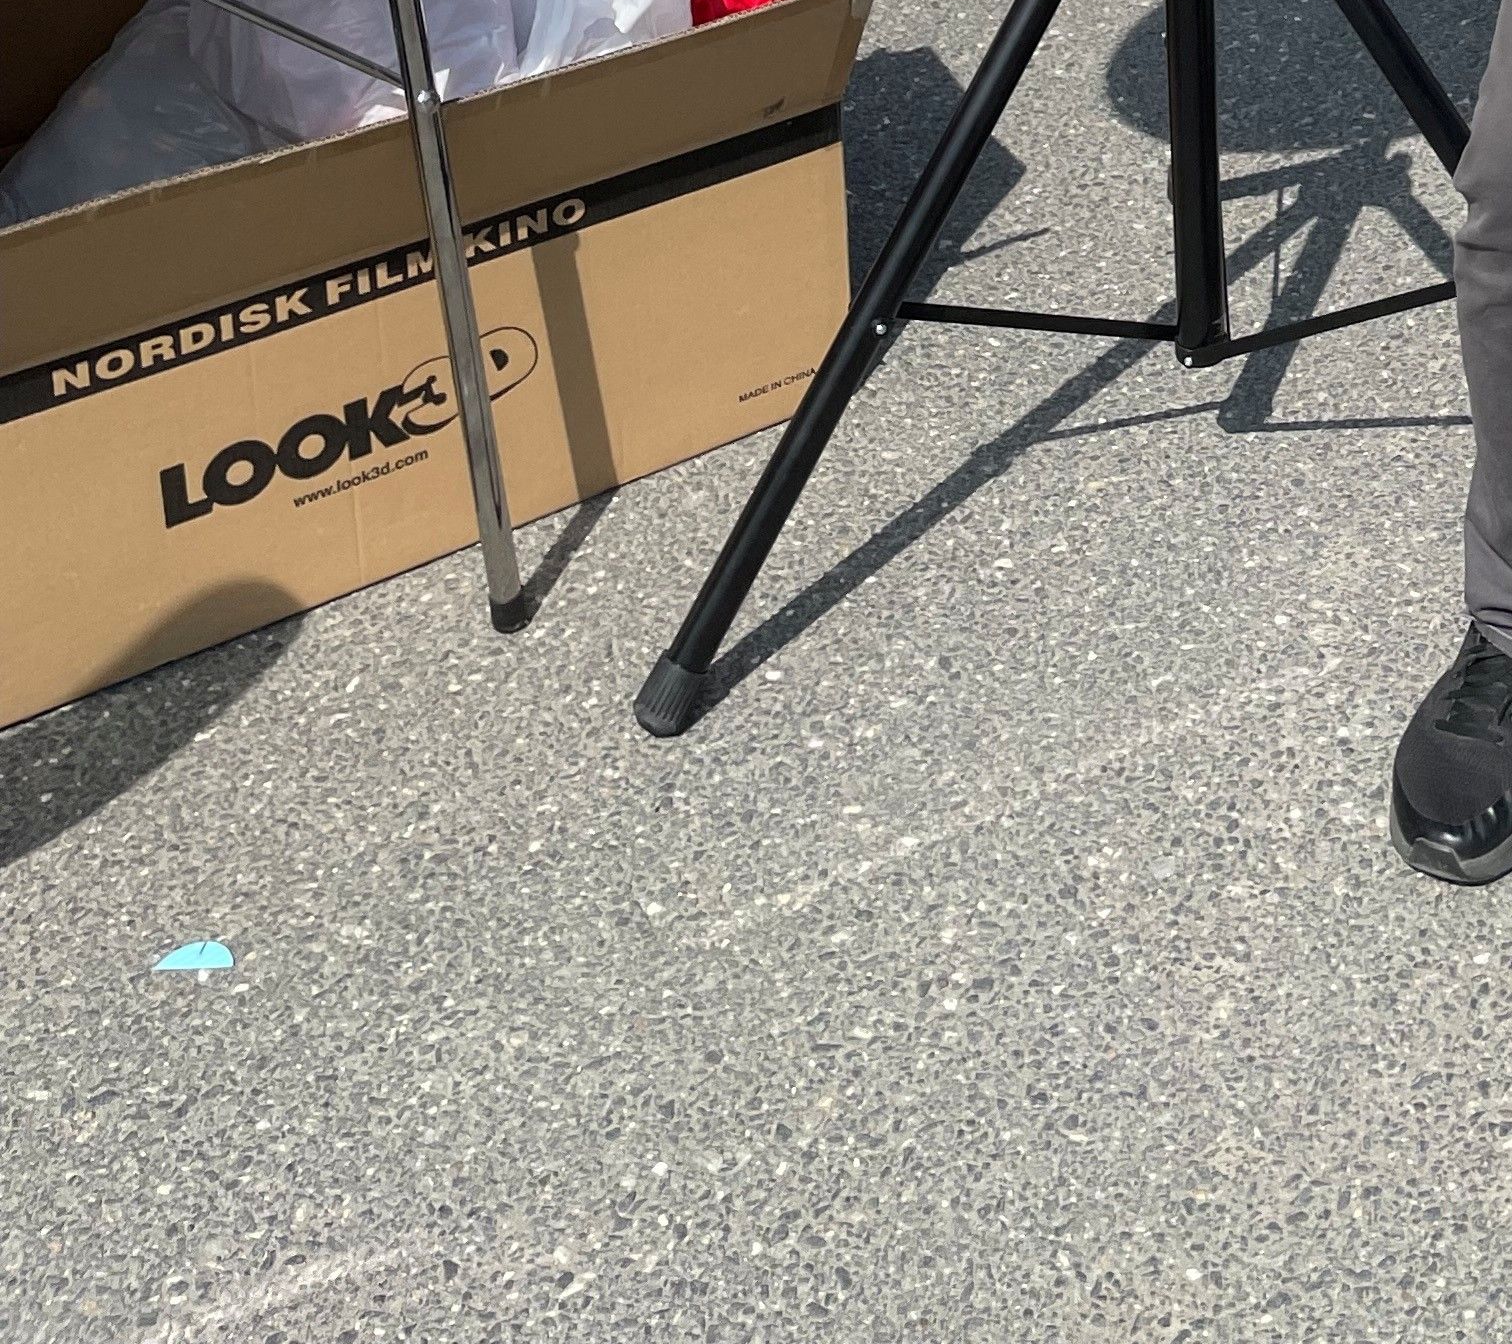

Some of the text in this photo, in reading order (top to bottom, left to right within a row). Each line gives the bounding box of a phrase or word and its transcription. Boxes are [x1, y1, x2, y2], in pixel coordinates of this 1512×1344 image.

[52, 197, 587, 398] NORDISK FILM KINO
[738, 367, 816, 402] MADE IN CHINA
[292, 447, 430, 509] www.look3d.com
